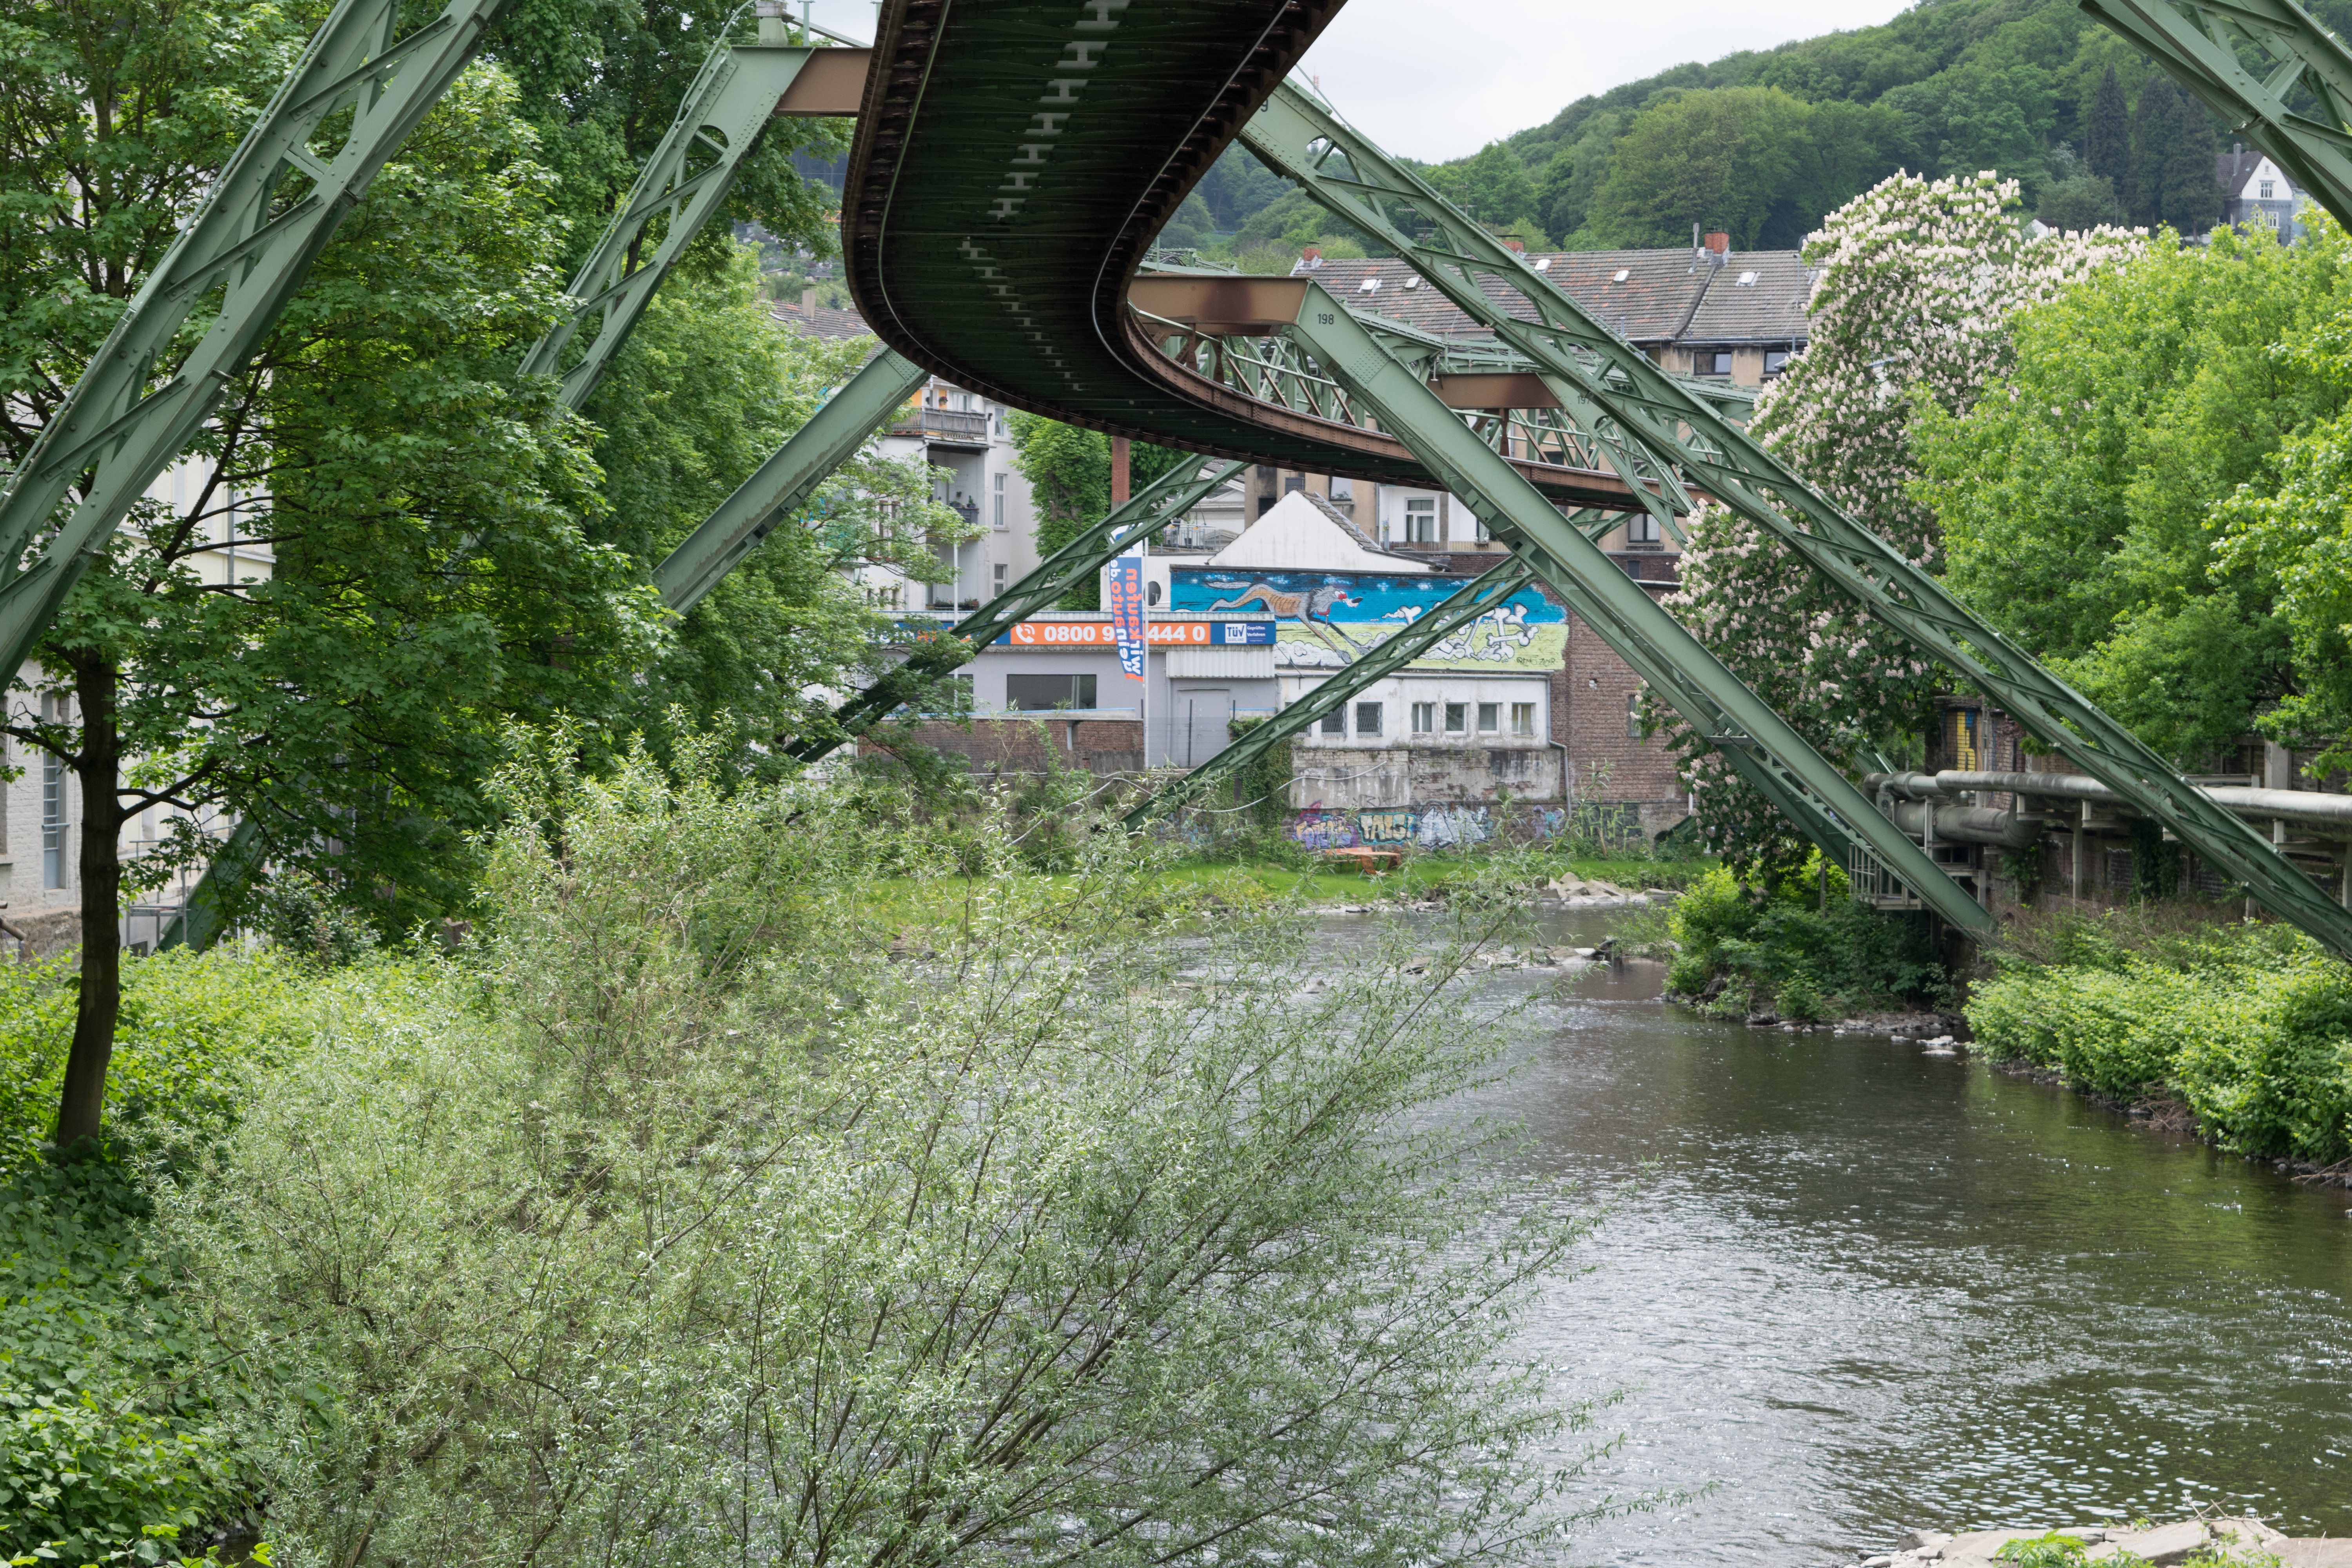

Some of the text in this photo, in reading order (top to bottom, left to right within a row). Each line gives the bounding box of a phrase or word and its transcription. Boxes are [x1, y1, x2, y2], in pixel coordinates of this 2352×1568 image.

[1317, 313, 1334, 325] 198
[1044, 626, 1096, 641] 0800
[1192, 626, 1205, 641] 0
[1227, 625, 1245, 637] TÜV
